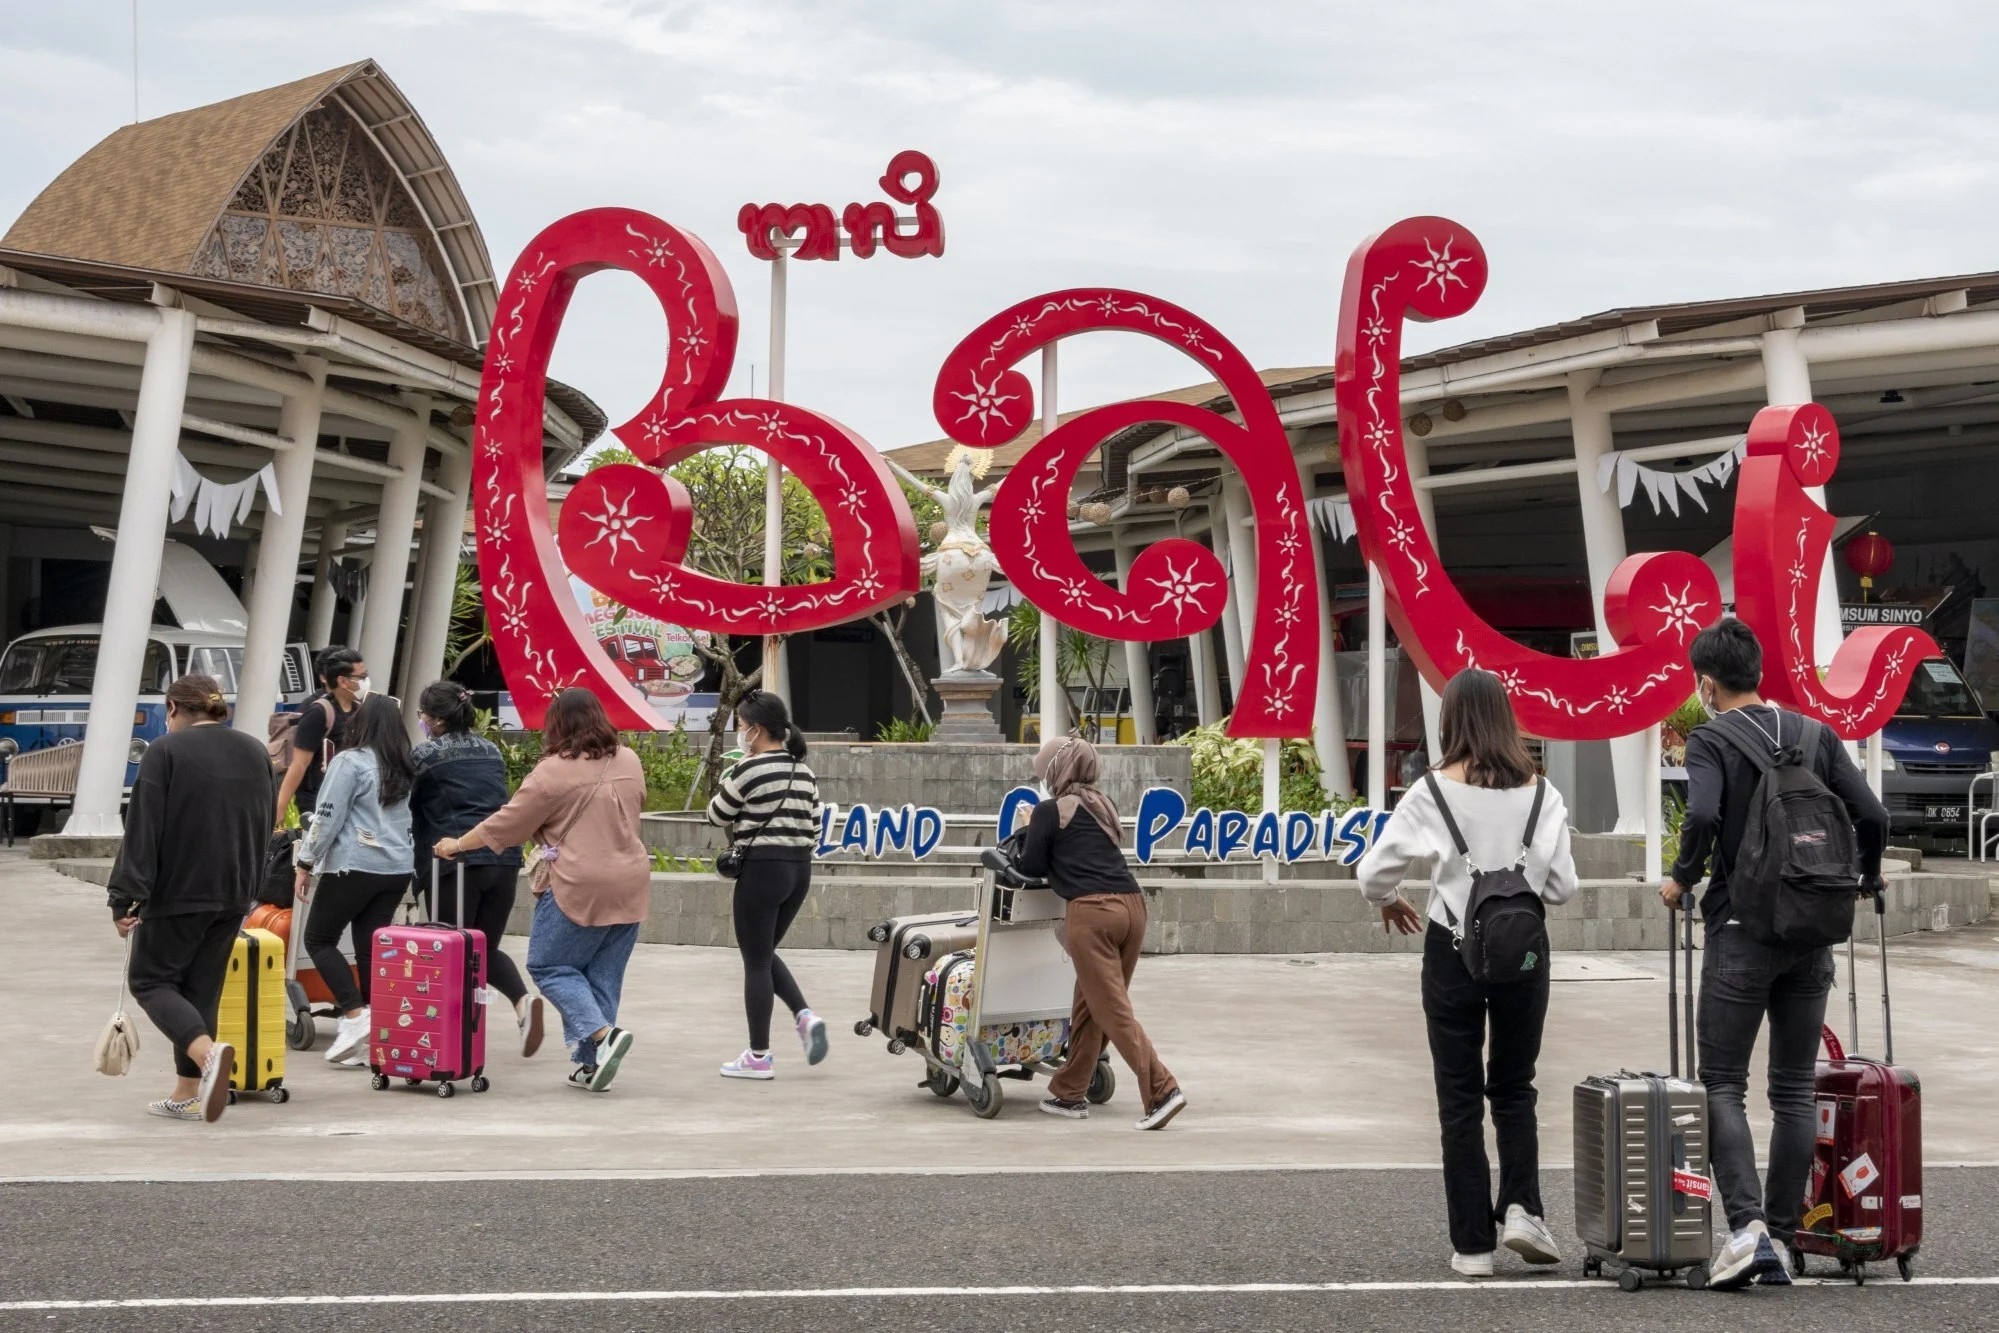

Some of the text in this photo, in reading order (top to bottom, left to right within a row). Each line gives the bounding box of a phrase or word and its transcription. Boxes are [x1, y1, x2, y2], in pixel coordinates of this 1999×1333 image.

[1839, 607, 1923, 622] MSUM SINYO
[666, 633, 709, 643] Telkosel
[1581, 642, 1600, 652] DIMSU
[814, 803, 944, 861] LAND
